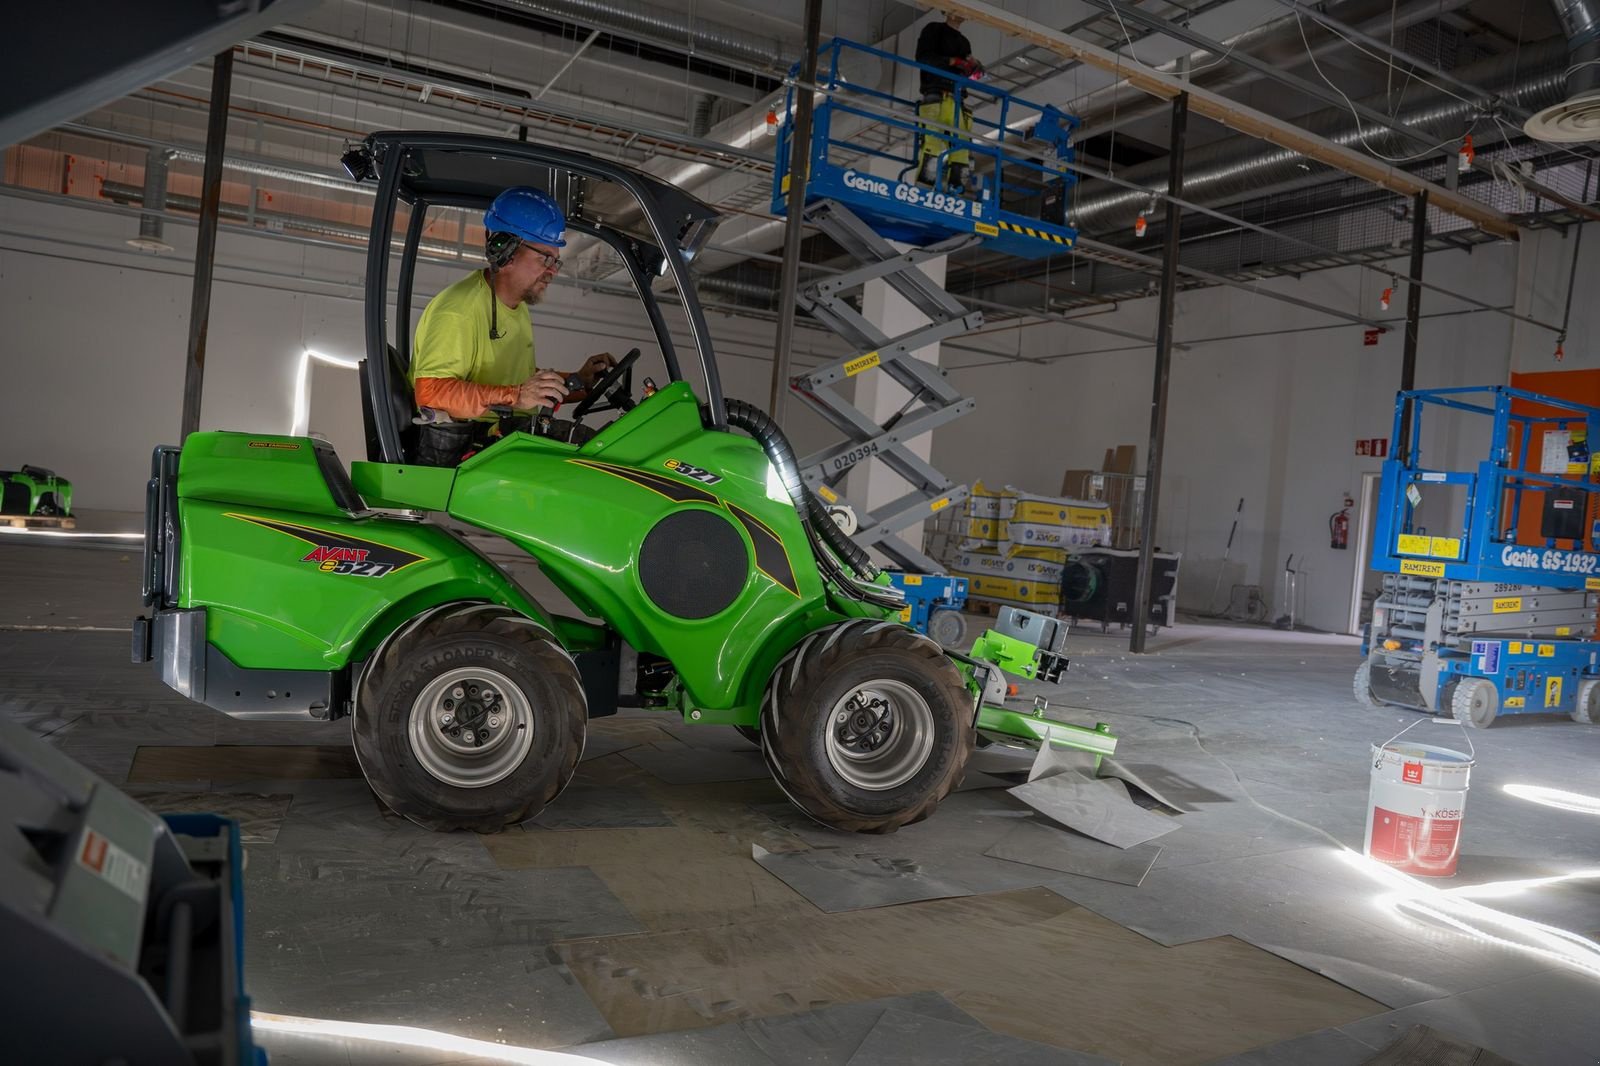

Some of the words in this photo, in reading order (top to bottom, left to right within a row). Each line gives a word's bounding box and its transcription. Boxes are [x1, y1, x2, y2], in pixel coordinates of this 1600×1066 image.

[843, 170, 890, 196] Genie
[895, 183, 966, 216] GS-1932
[846, 354, 878, 373] RAMIRENT
[834, 442, 879, 469] 020394
[664, 459, 723, 485] e527
[300, 546, 370, 562] AVANT
[1502, 545, 1538, 569] Genie
[1542, 550, 1597, 574] GS-1932
[319, 560, 394, 578] e527
[1403, 563, 1442, 574] RAMIRENT
[433, 646, 495, 668] LOADER
